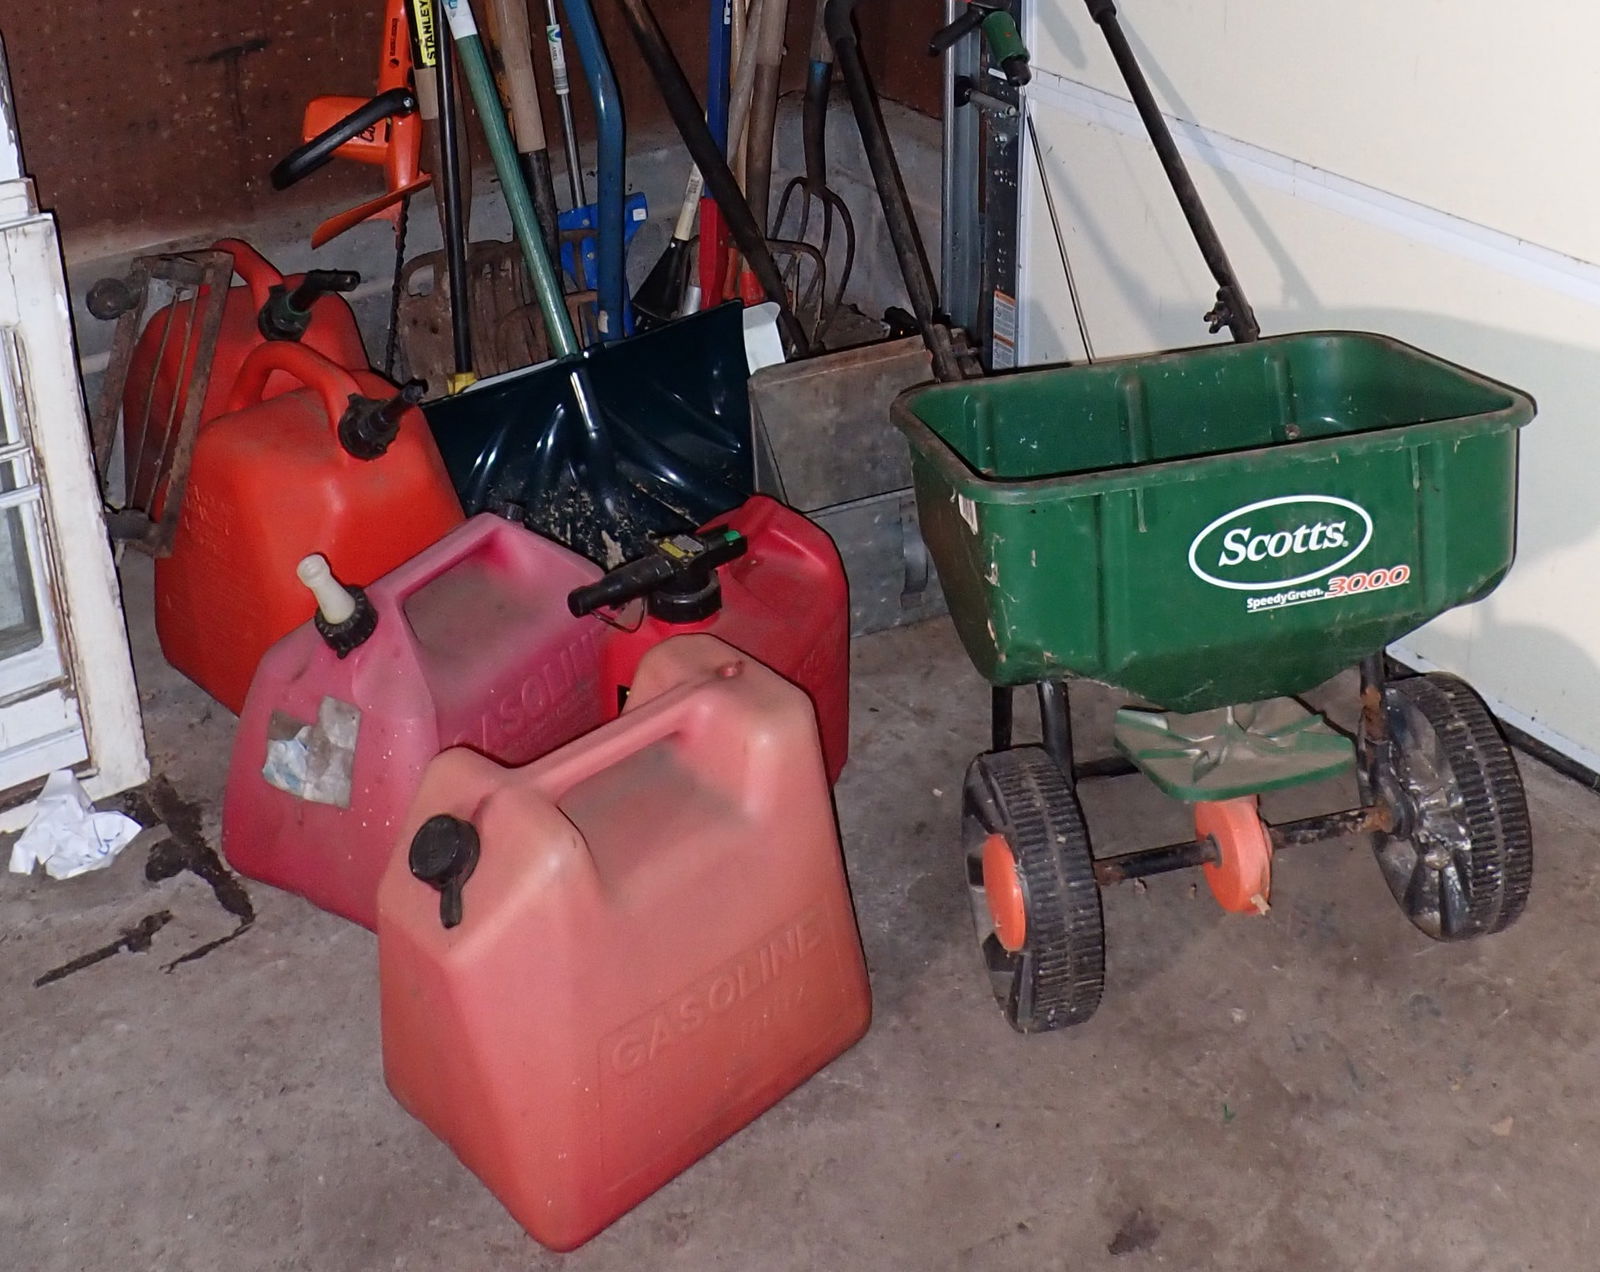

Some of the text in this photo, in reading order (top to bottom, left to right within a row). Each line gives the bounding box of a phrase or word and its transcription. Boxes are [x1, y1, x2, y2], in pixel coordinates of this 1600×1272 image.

[1218, 521, 1347, 567] Scotts
[1247, 564, 1411, 610] SpeedyGreen 3000
[610, 918, 825, 1076] GASOLINE
